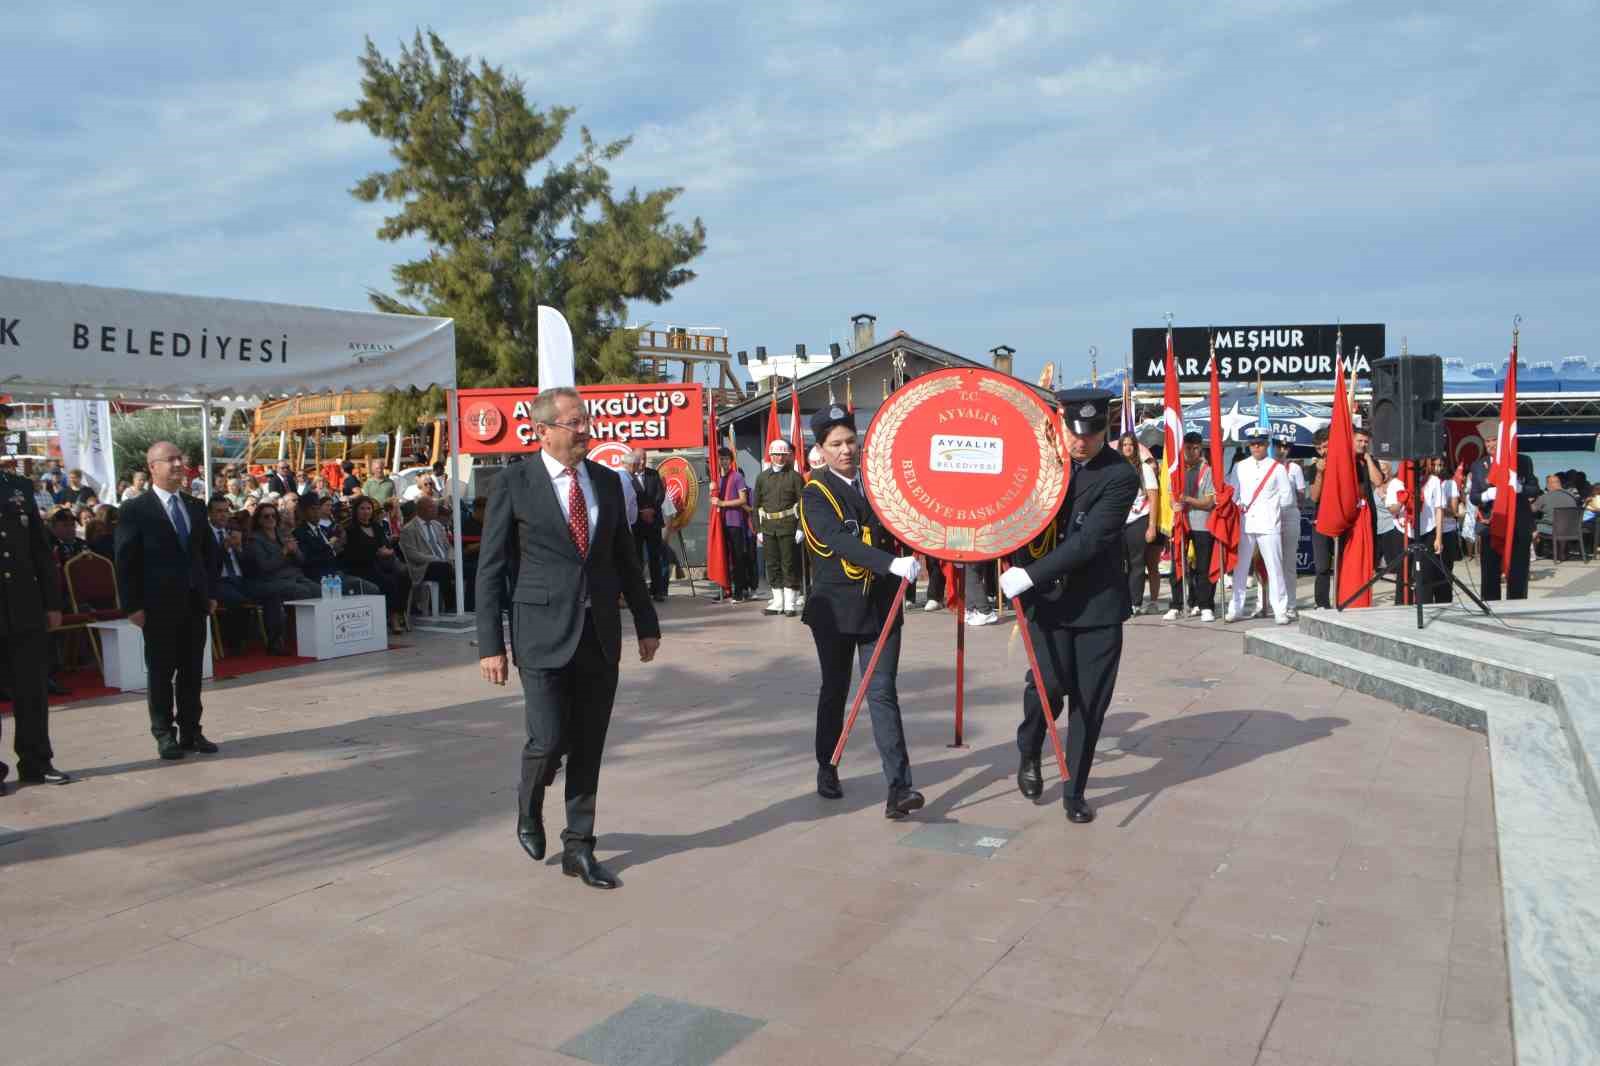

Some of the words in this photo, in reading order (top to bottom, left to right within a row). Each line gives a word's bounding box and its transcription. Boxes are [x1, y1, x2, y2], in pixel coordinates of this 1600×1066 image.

[73, 323, 287, 363] BELEDİYESİ
[1215, 329, 1304, 352] MEŞHUR
[938, 407, 1000, 426] AYVALIK
[937, 438, 997, 449] AYVALIK
